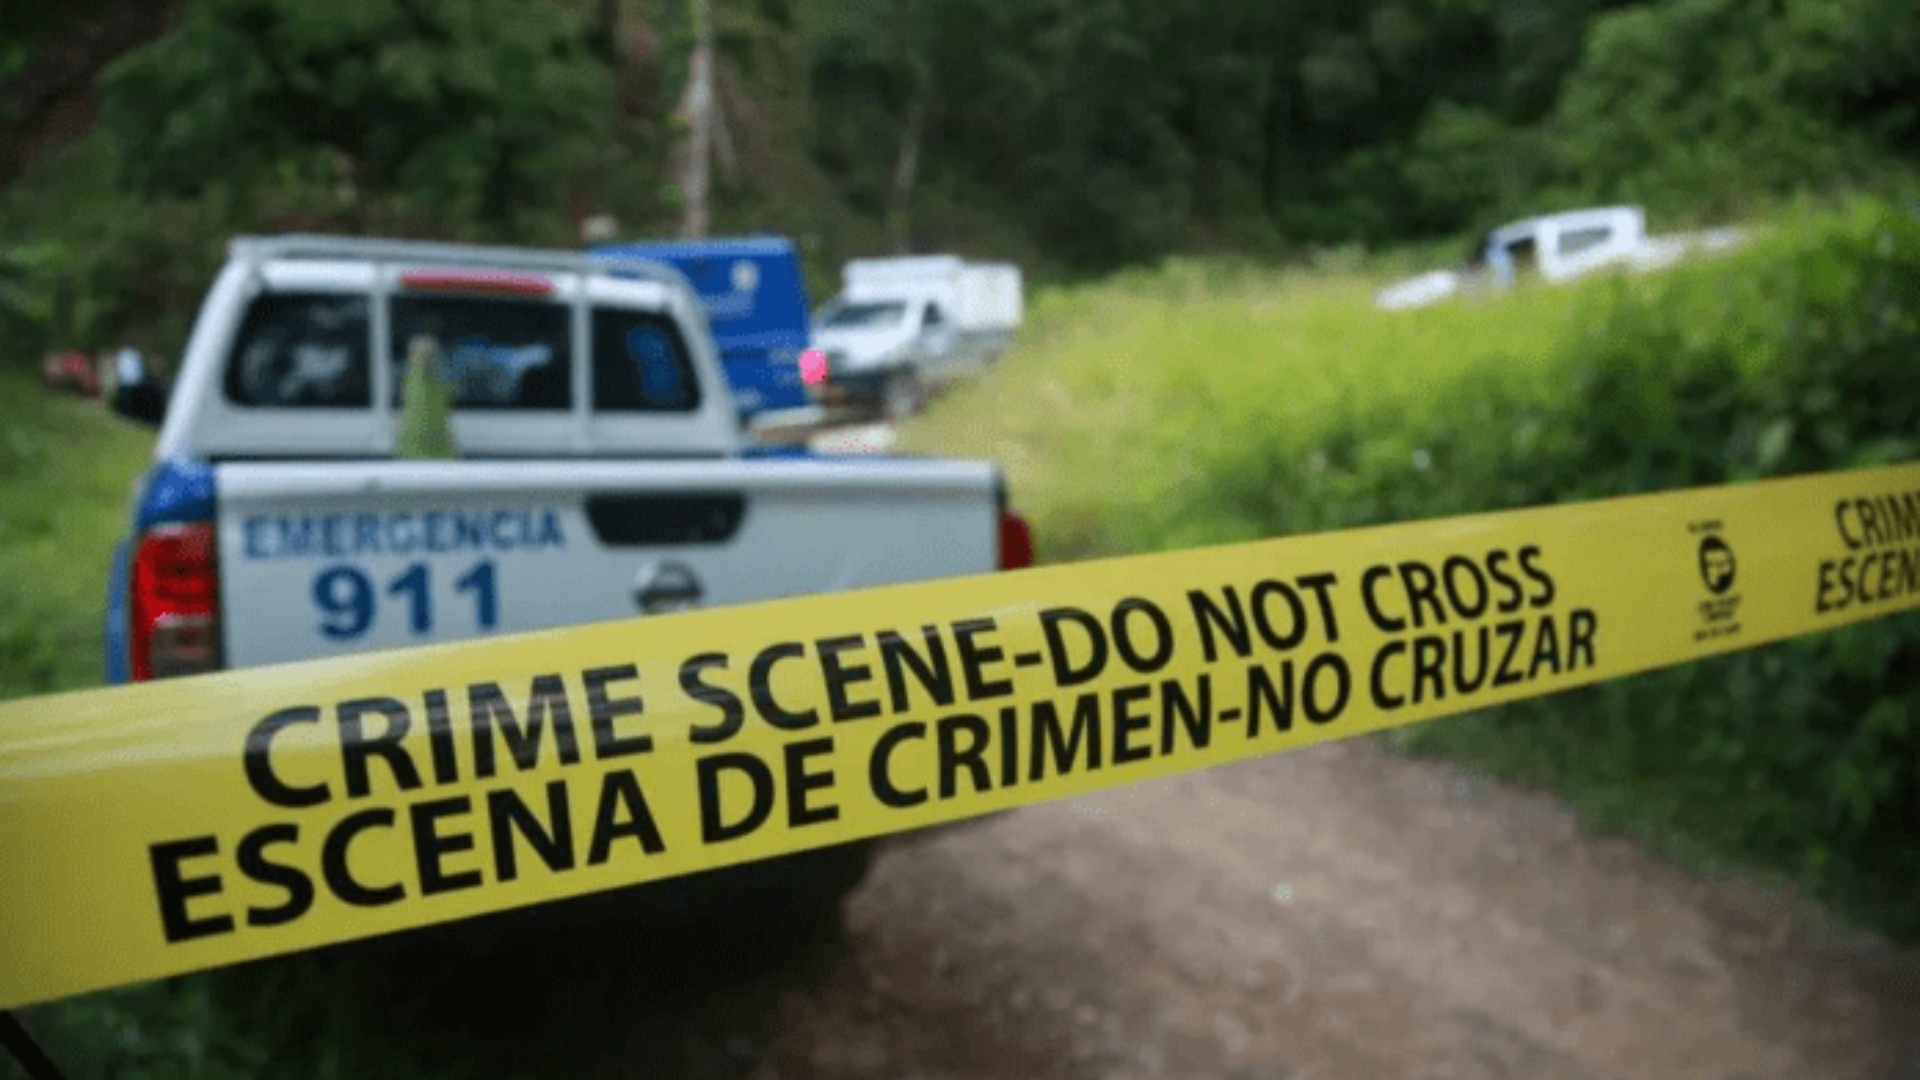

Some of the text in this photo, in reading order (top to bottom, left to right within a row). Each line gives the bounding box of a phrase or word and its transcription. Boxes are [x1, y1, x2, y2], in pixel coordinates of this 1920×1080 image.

[243, 507, 566, 560] EMERGENCIA
[1835, 490, 1920, 550] CRIM
[312, 561, 498, 639] 911
[242, 546, 1556, 808] CRIME SCENE-DO NOT CROSS
[149, 608, 1598, 944] ESCENA DE CRIMEN-NO CRUZAR
